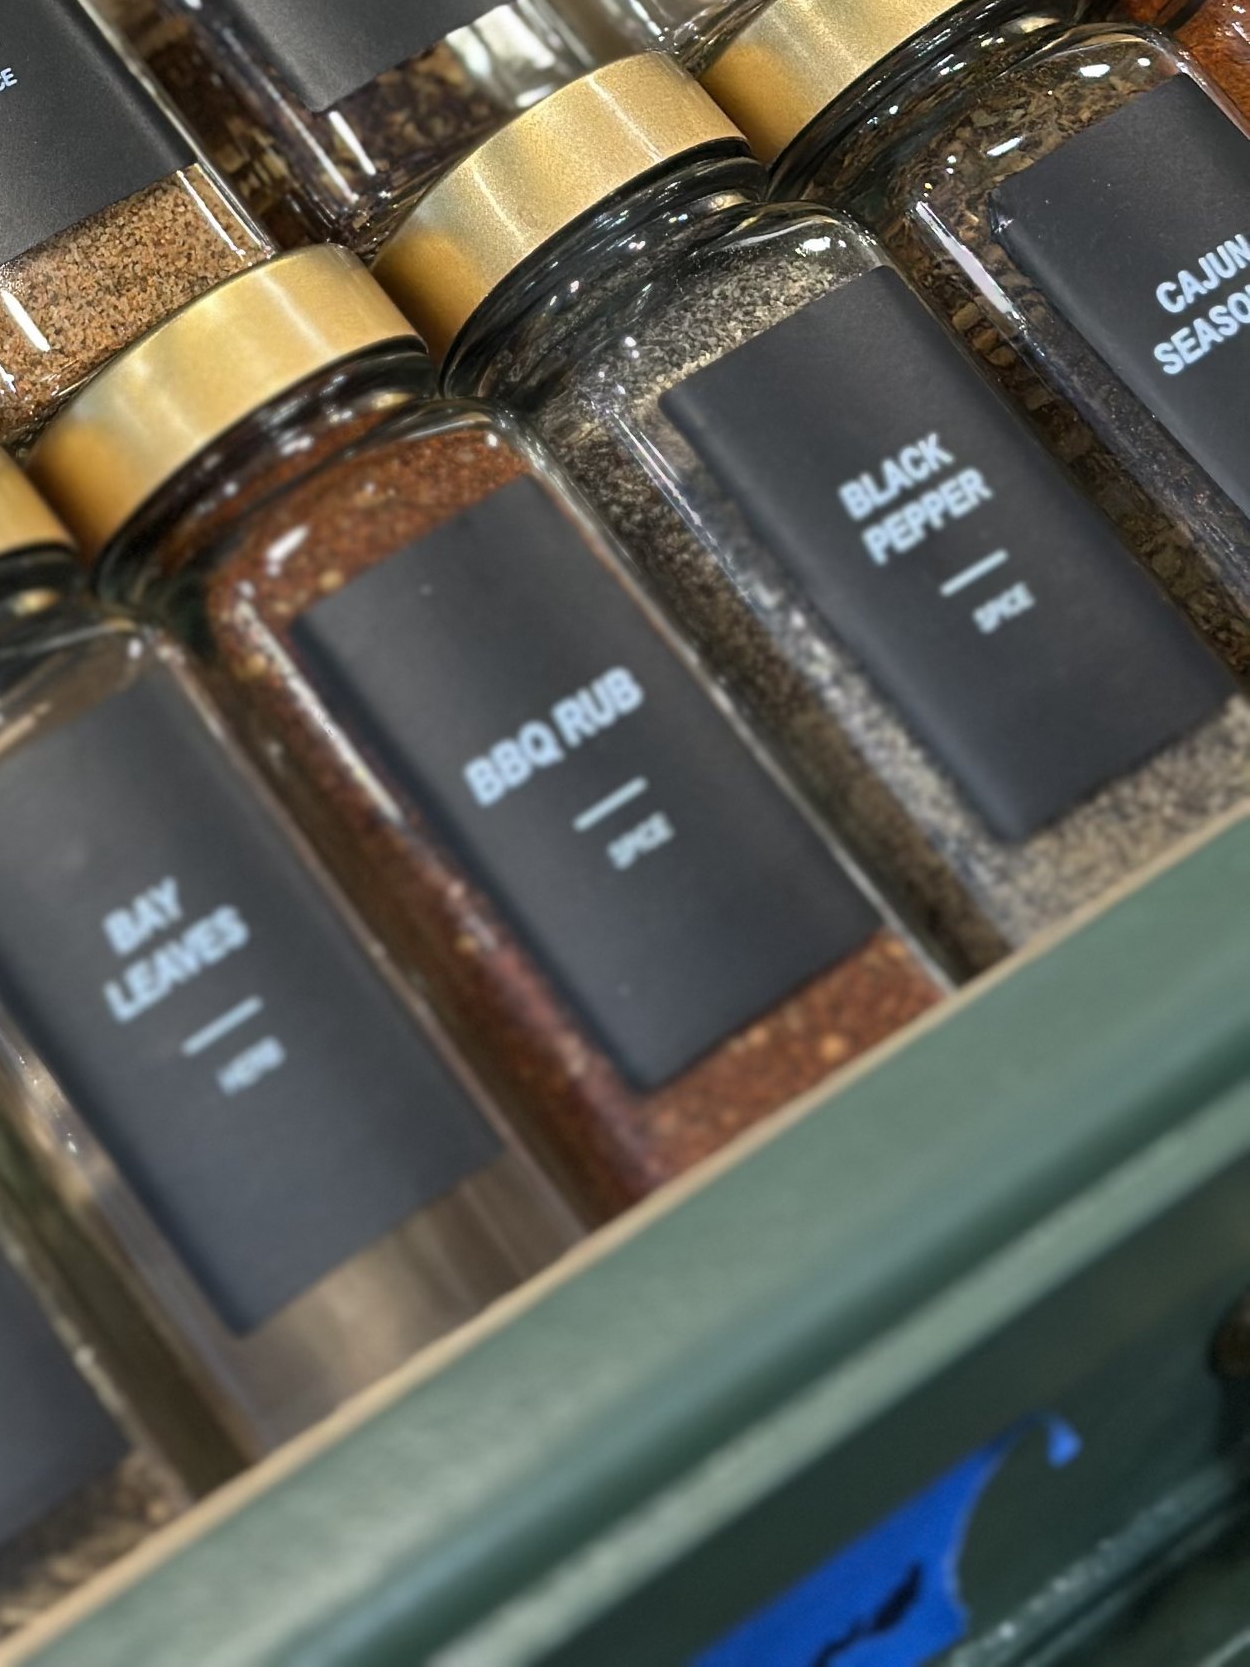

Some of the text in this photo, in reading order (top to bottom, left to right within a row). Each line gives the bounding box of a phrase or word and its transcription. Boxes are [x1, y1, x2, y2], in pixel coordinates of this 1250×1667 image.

[1156, 234, 1250, 313] CAJUN
[1154, 284, 1250, 375] SEASO
[838, 432, 954, 520] BLACK
[862, 465, 993, 566] PEPPER
[464, 666, 644, 808] BBQ RUB
[103, 875, 182, 957] BAY
[103, 904, 250, 1023] LEAVES
